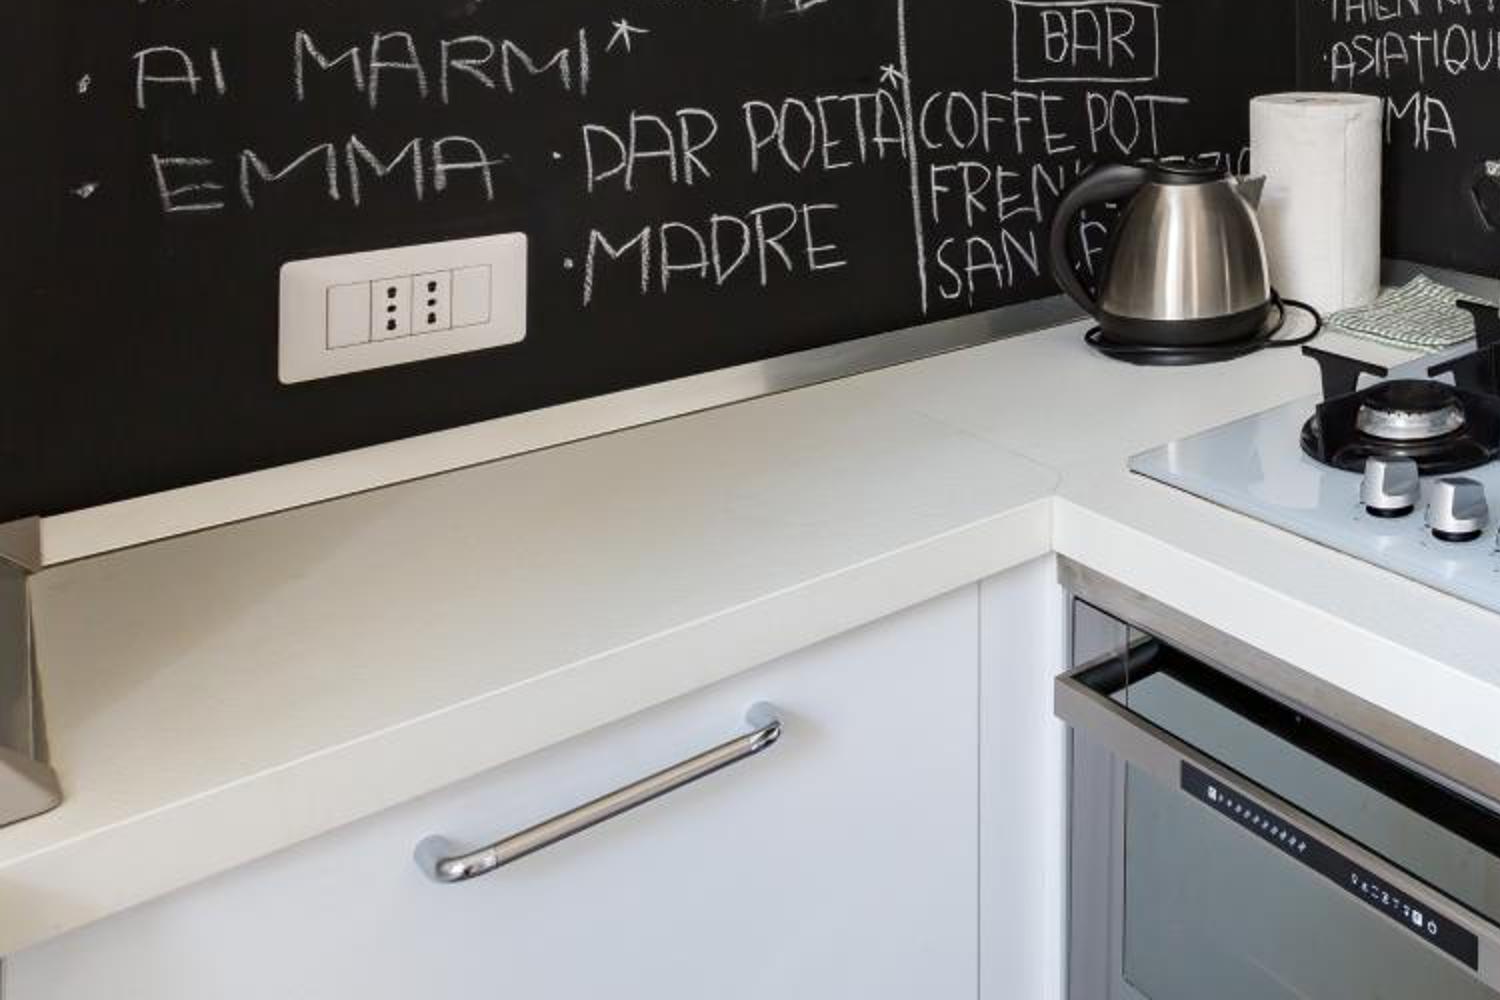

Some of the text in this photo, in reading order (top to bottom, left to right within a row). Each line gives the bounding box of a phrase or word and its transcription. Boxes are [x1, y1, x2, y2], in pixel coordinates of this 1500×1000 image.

[133, 29, 590, 109] AI MARMI
[1040, 6, 1136, 68] BAR
[582, 89, 907, 192] DAR POETA
[920, 89, 1190, 154] COFFE POT
[1382, 91, 1457, 151] MA
[152, 135, 503, 213] EMMA
[583, 202, 847, 307] MADRE
[937, 227, 1041, 308] SAN
